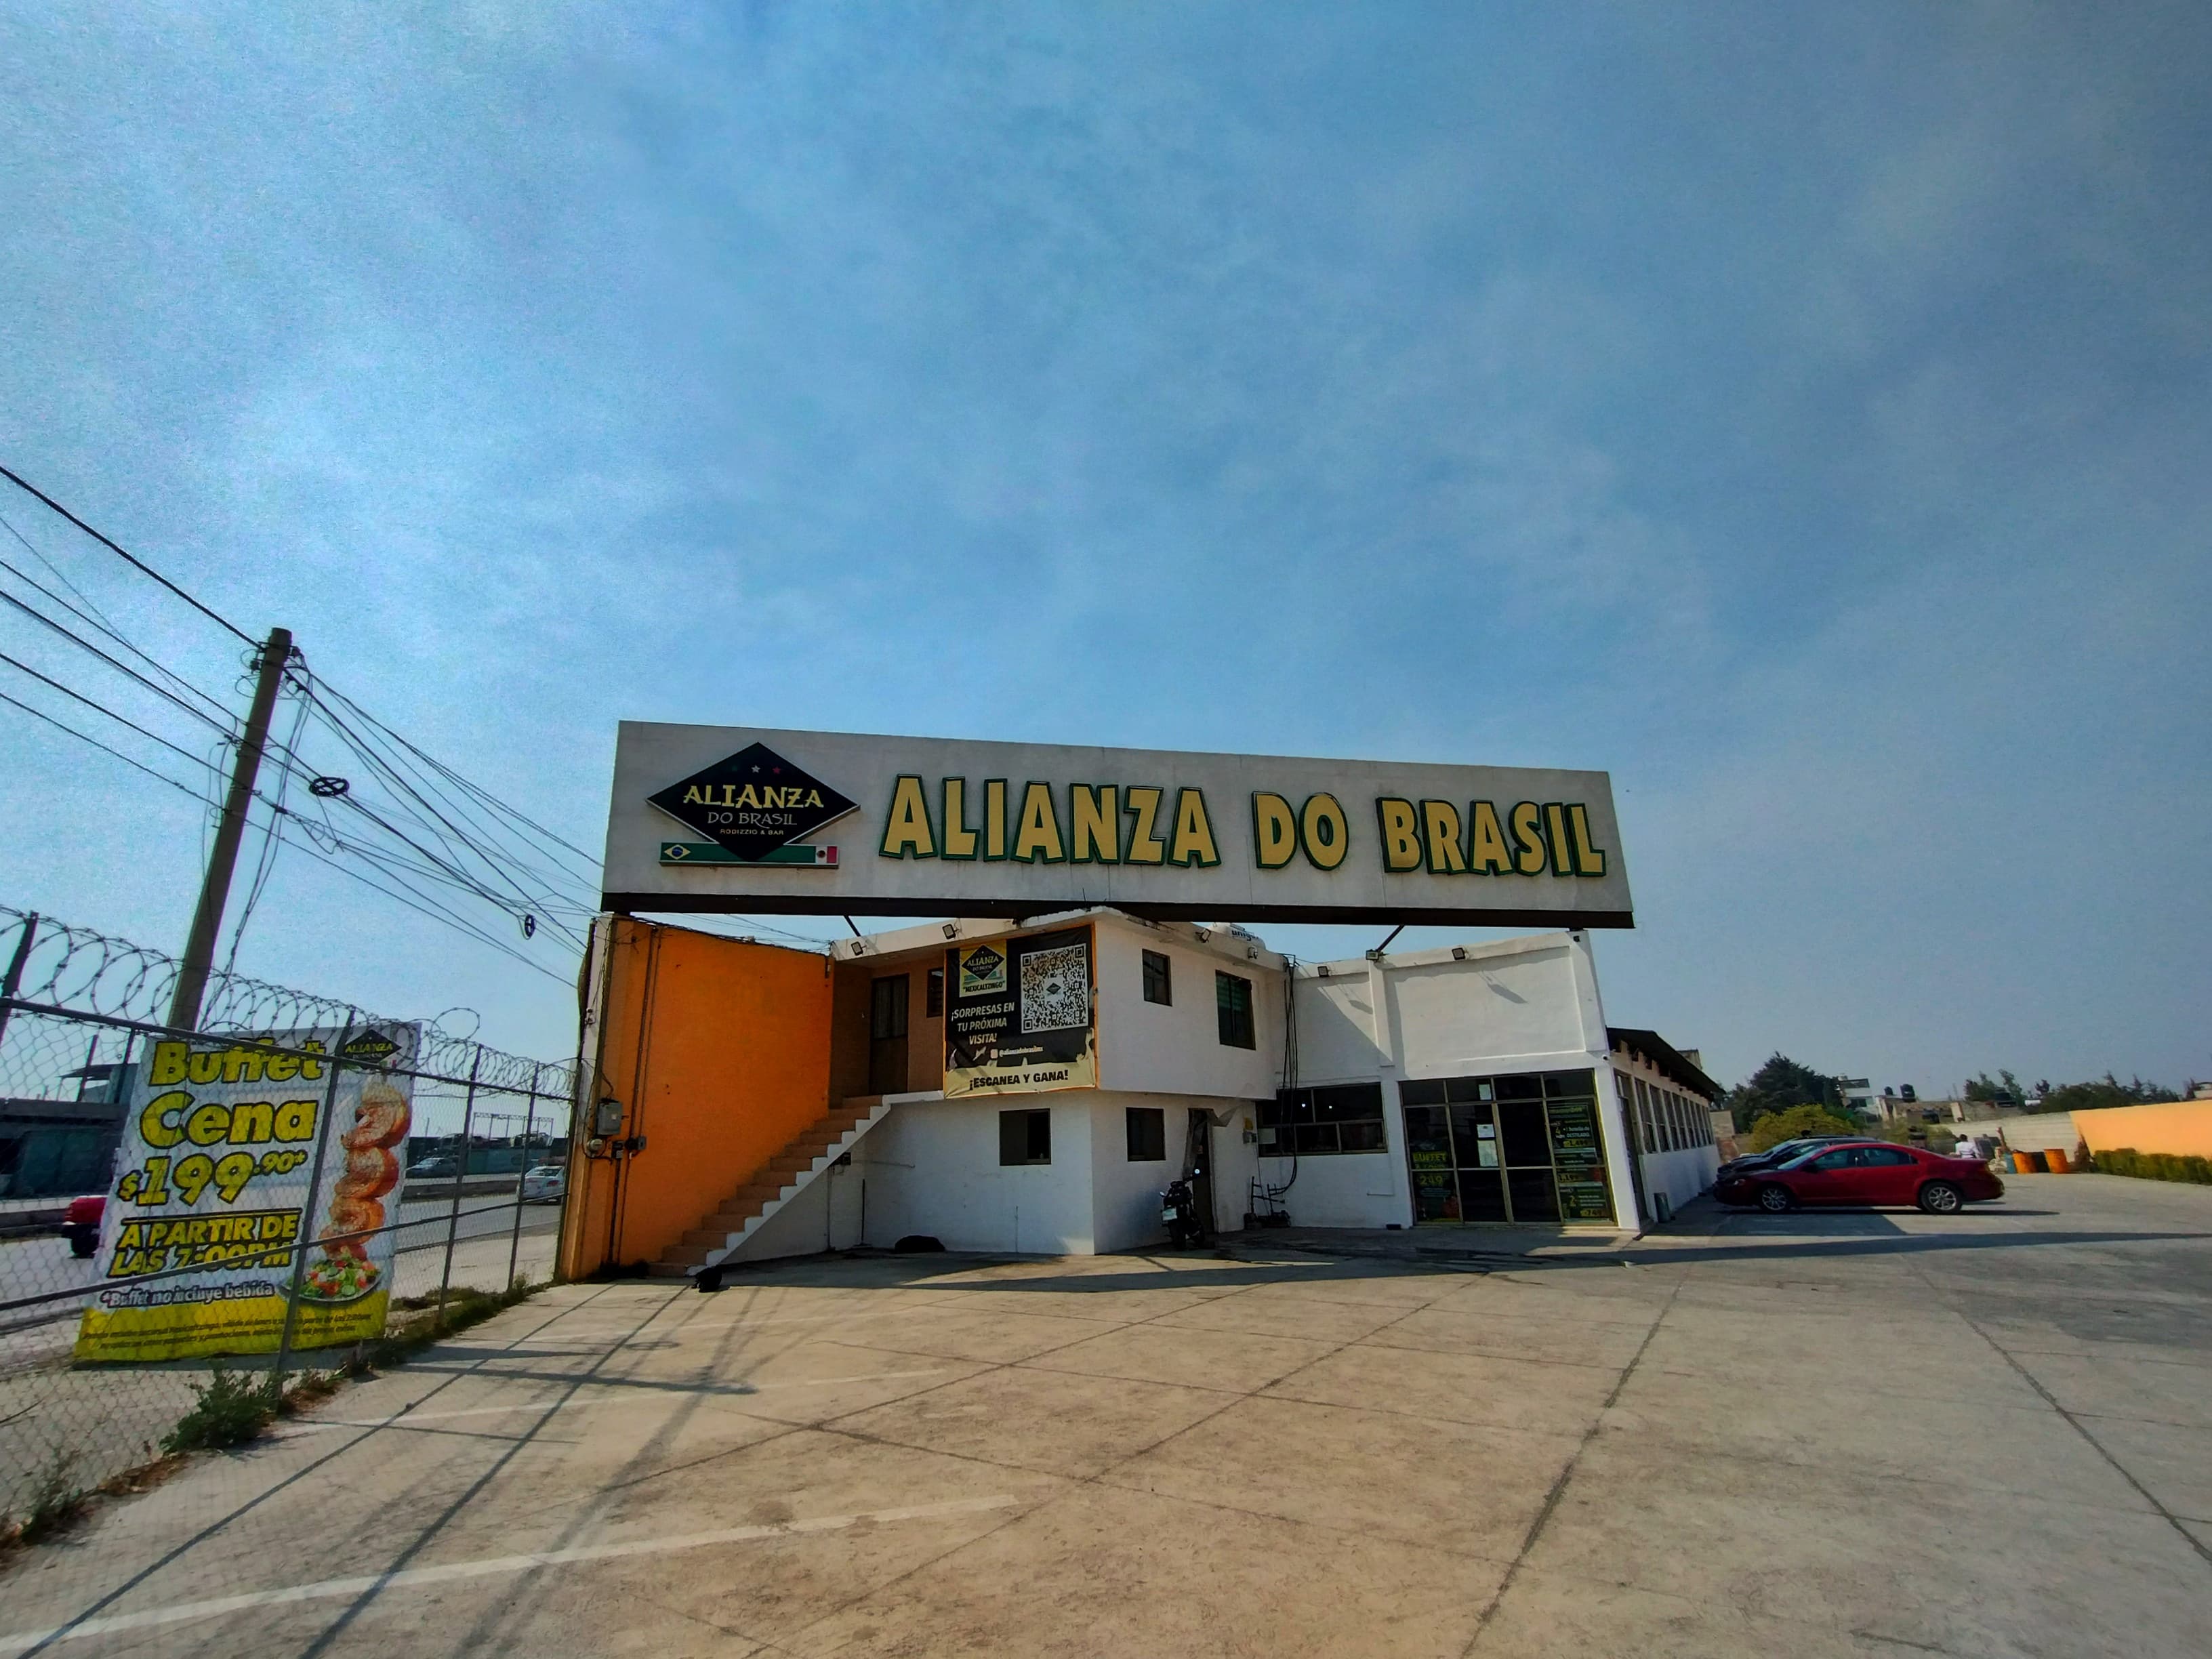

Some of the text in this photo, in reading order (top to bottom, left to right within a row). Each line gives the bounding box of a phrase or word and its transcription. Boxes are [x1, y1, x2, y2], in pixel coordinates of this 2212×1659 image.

[683, 784, 824, 808] ALIANZA
[708, 812, 798, 829] DO BRASIL
[879, 774, 1605, 877] ALIANZA DO BRASIL
[967, 956, 999, 966] ALIANZA
[951, 1002, 1015, 1022] ¡SORPRESAS EN
[957, 1017, 1007, 1032] TU PRÓXIMA
[969, 1033, 998, 1045] VISITA!
[148, 1037, 327, 1086] Buffet
[969, 1069, 1069, 1090] ¡ESCANEA Y GANA!
[140, 1090, 319, 1149] Cena
[117, 1213, 300, 1249] A PARTIR DE
[106, 1250, 169, 1278] LAS
[151, 1288, 171, 1305] no
[224, 1281, 276, 1300] bebida
